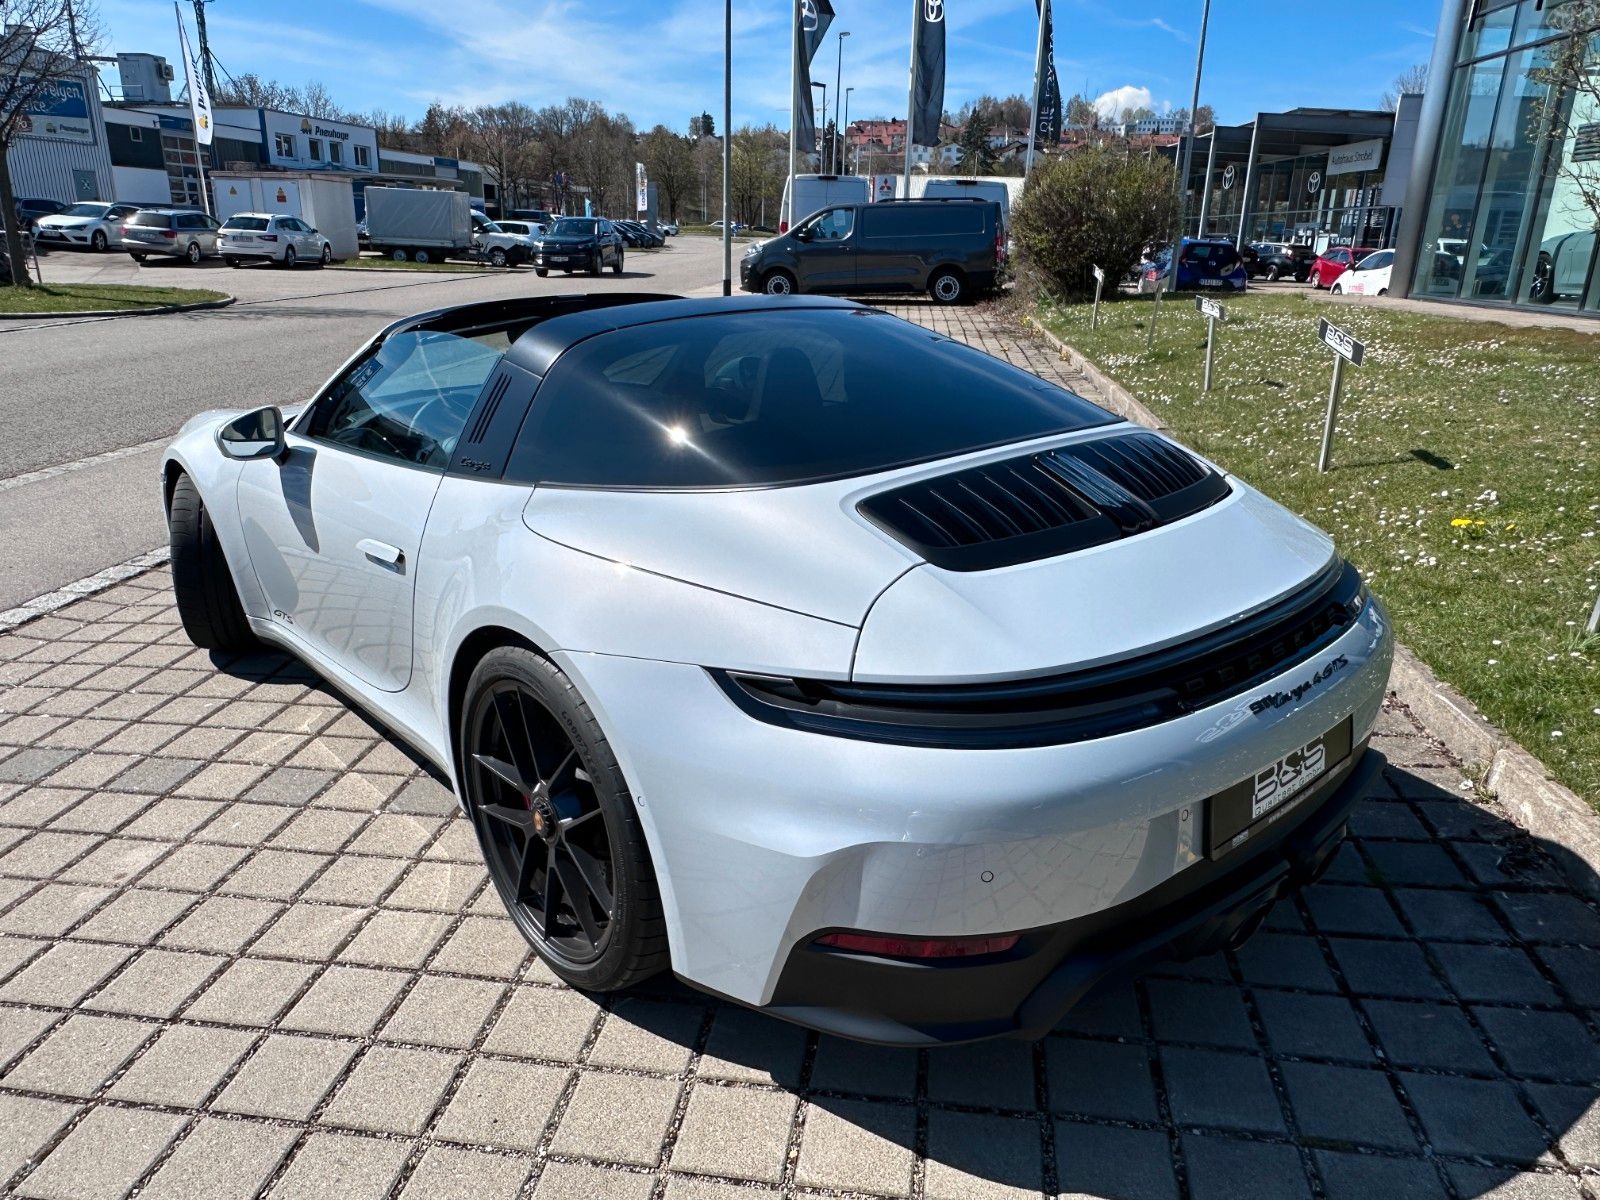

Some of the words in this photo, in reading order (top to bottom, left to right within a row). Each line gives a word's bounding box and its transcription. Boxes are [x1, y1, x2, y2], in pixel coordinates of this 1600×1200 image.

[314, 125, 350, 141] Pneuhage
[273, 609, 294, 624] GTS
[1322, 653, 1349, 679] GTS
[1253, 735, 1325, 806] B&S
